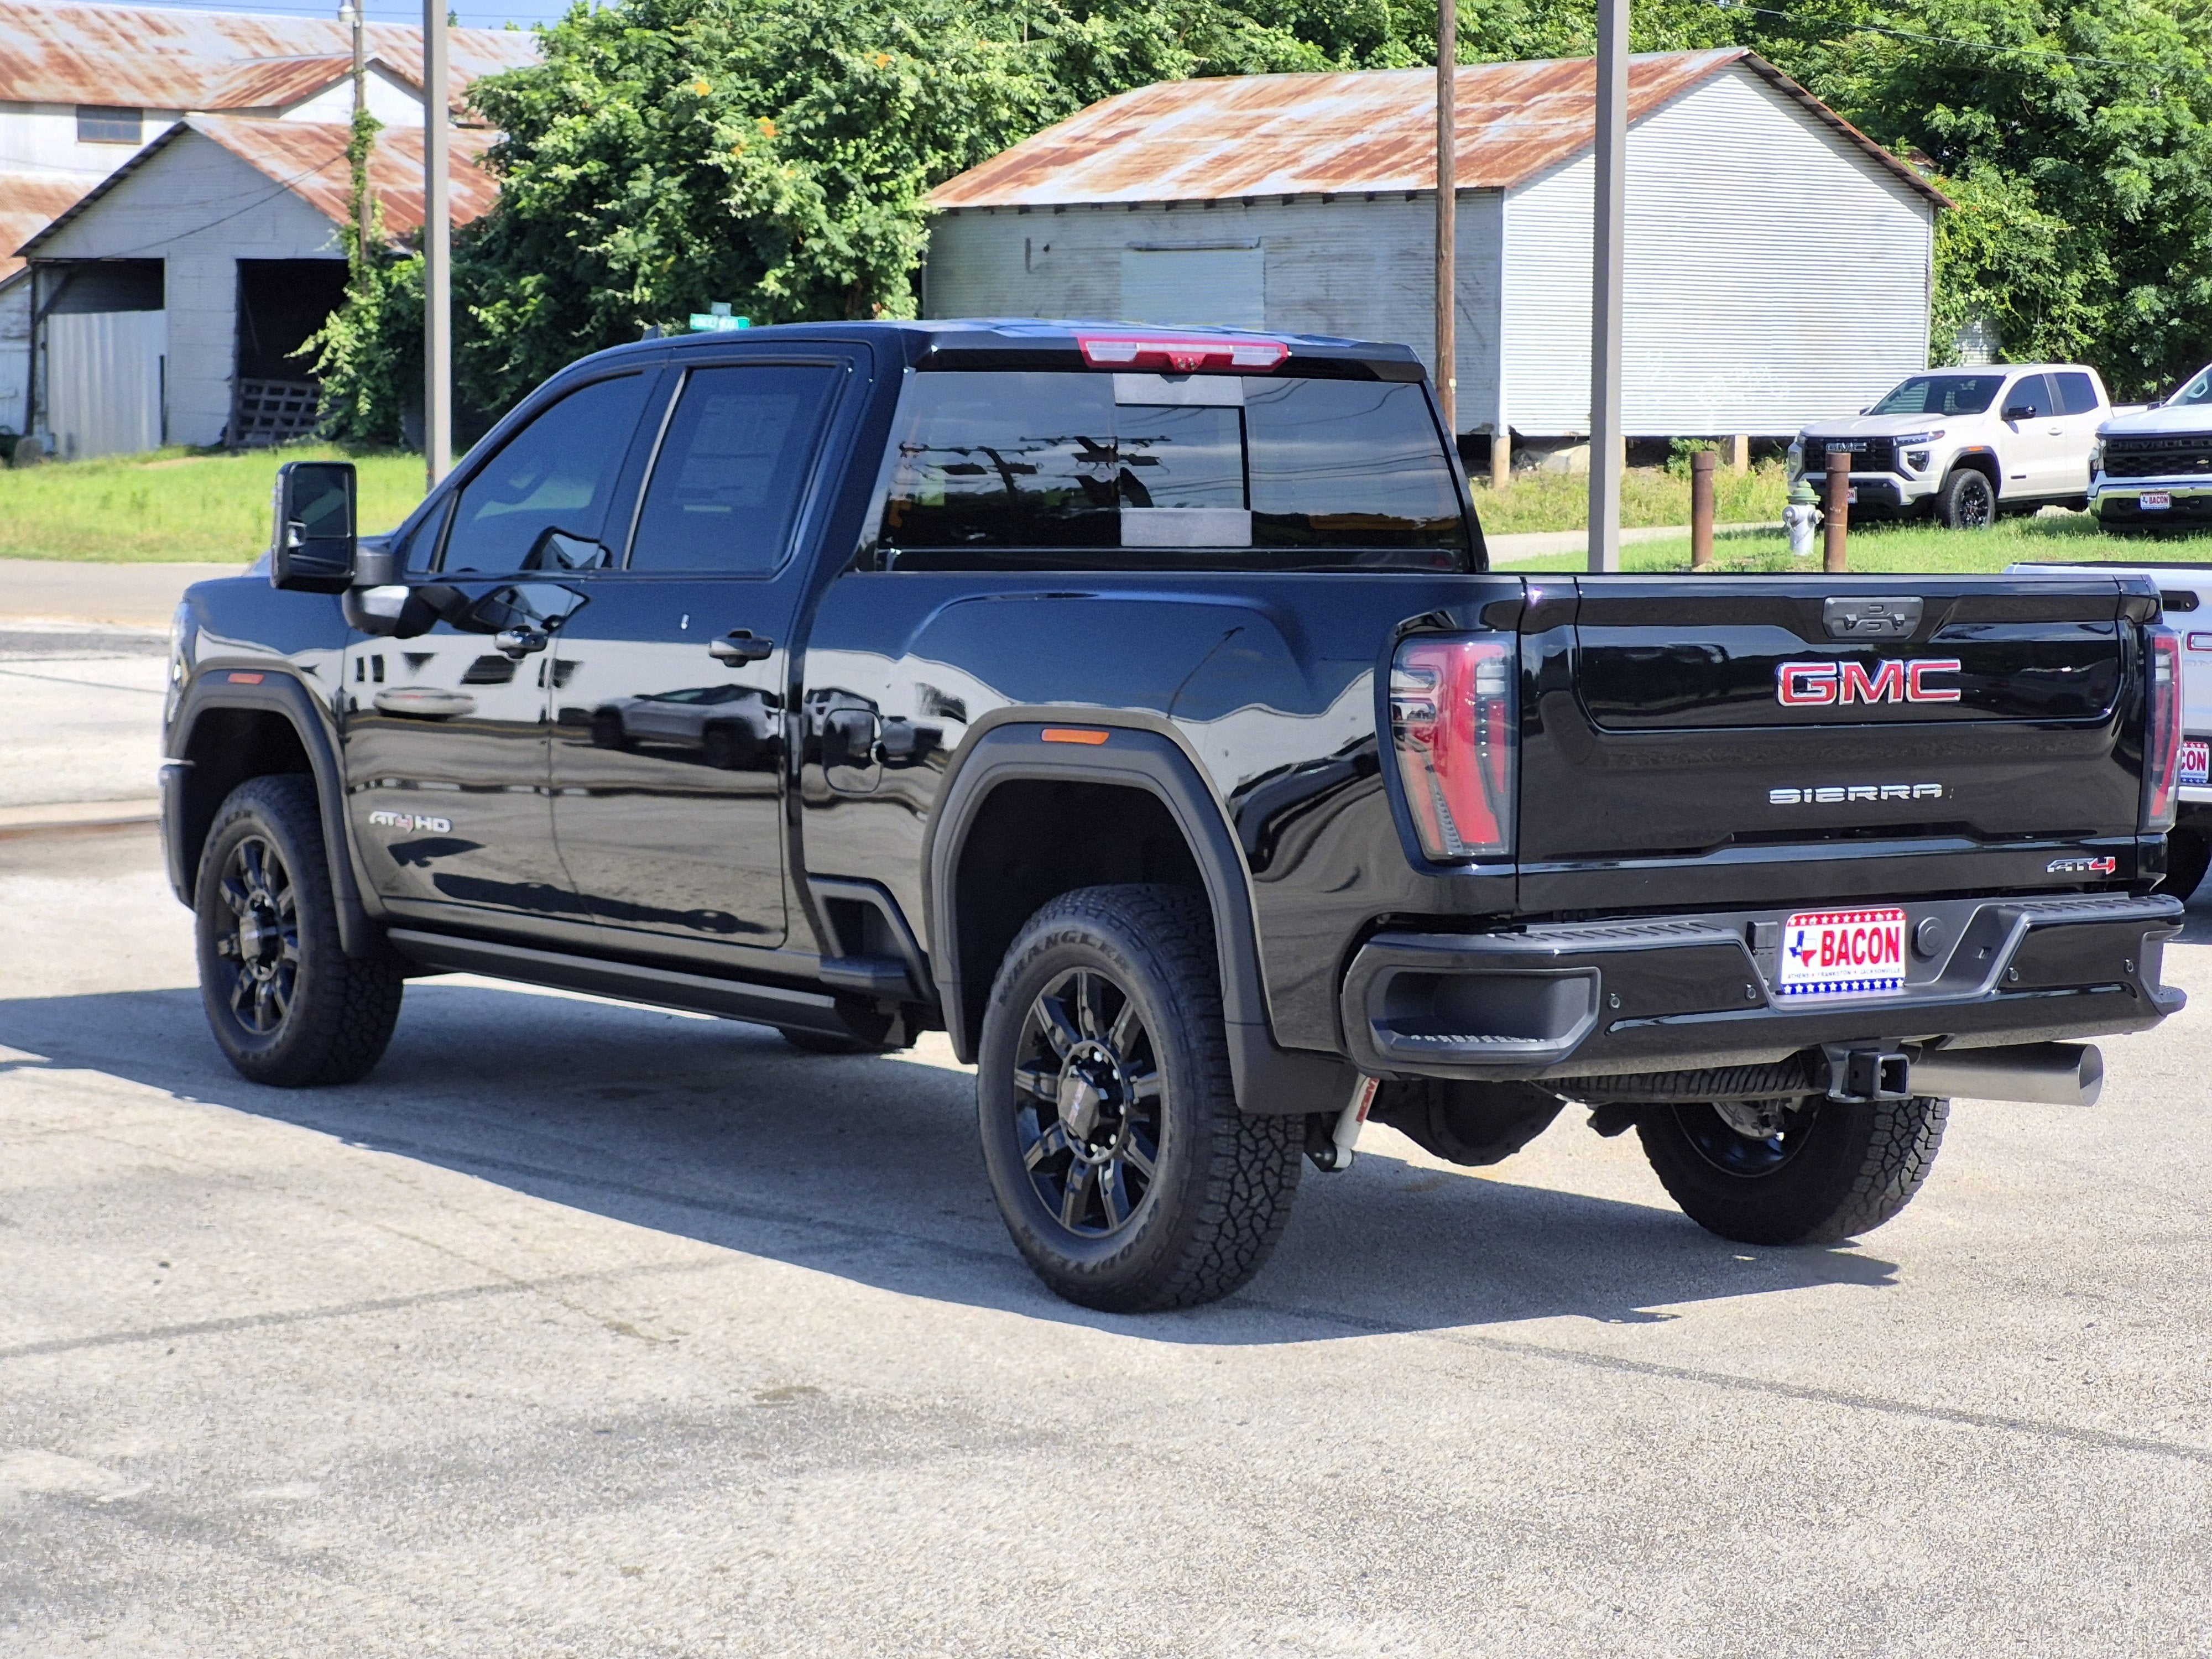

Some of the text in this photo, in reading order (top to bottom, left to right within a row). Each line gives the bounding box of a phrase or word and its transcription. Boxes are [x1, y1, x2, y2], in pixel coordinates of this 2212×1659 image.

[1826, 442, 1867, 452] GMC
[1775, 659, 1961, 707] GMC
[1768, 783, 1943, 804] SIERRA
[2047, 857, 2116, 875] AT4
[1820, 927, 1900, 967] BACON
